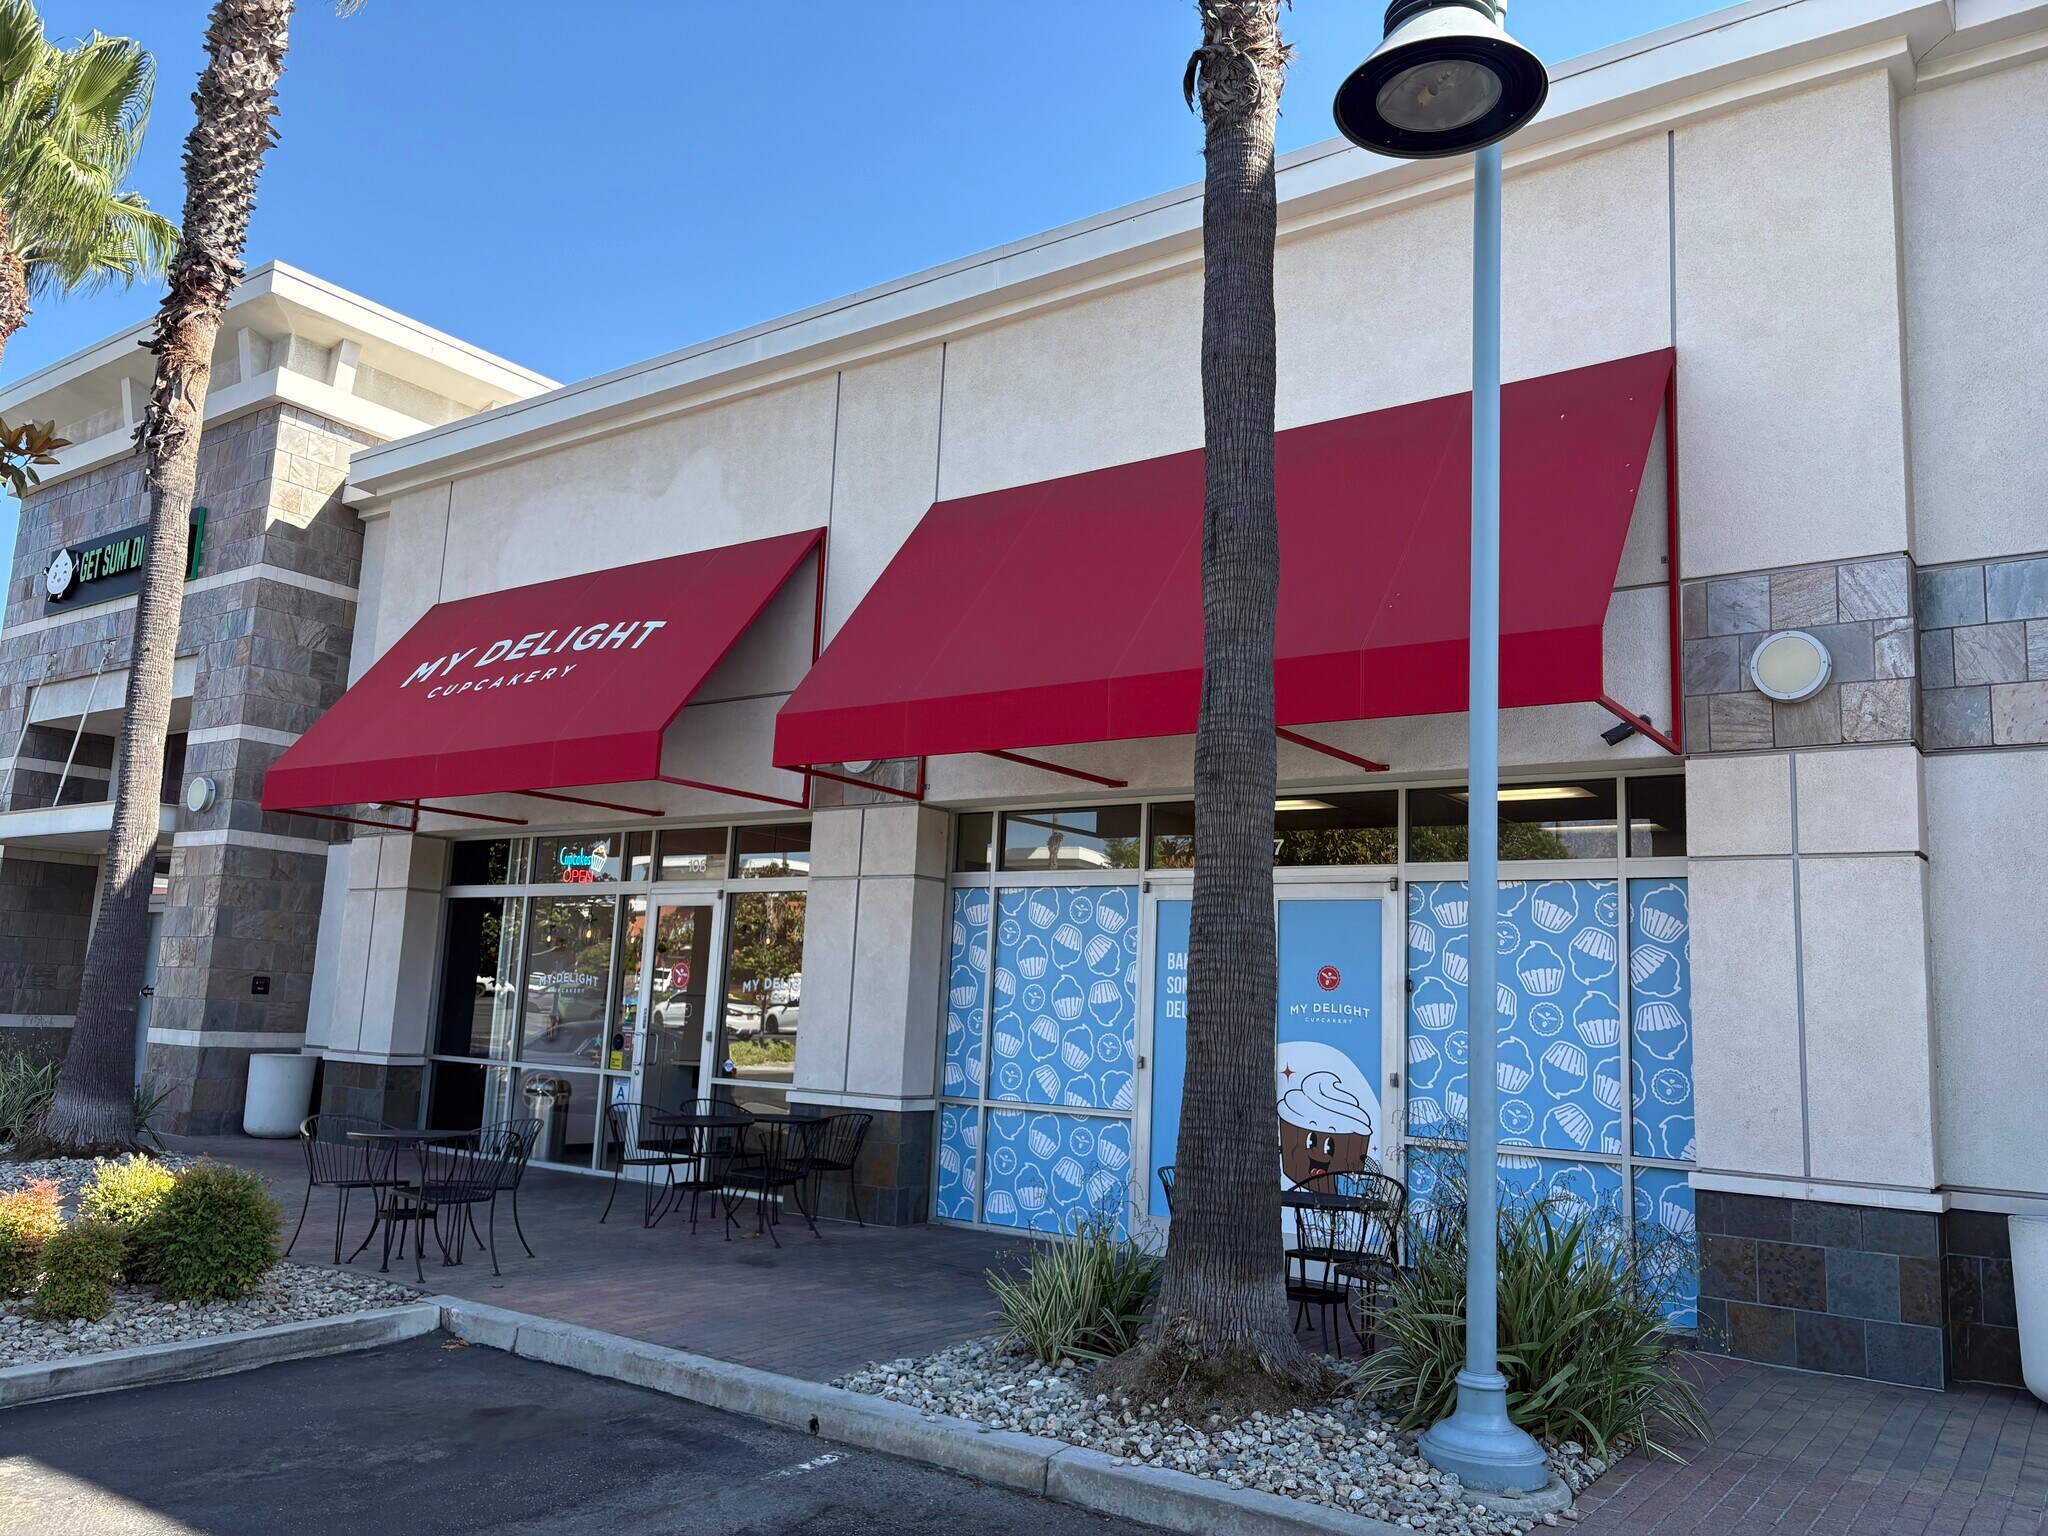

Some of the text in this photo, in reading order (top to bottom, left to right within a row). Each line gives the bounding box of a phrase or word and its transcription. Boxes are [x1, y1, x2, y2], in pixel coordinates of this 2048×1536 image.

[80, 535, 146, 583] GET SUM DI
[400, 621, 667, 688] MY DELIGHT
[427, 663, 577, 699] CUPCAKERY
[560, 846, 592, 870] Cupcakes
[688, 859, 707, 873] 108
[563, 869, 594, 884] OPEN
[539, 972, 598, 986] MY DELIGHT
[742, 977, 801, 993] MY DELIG
[1166, 1000, 1188, 1019] DEL
[1290, 1003, 1371, 1019] MY DELIGHT
[616, 1086, 625, 1100] A
